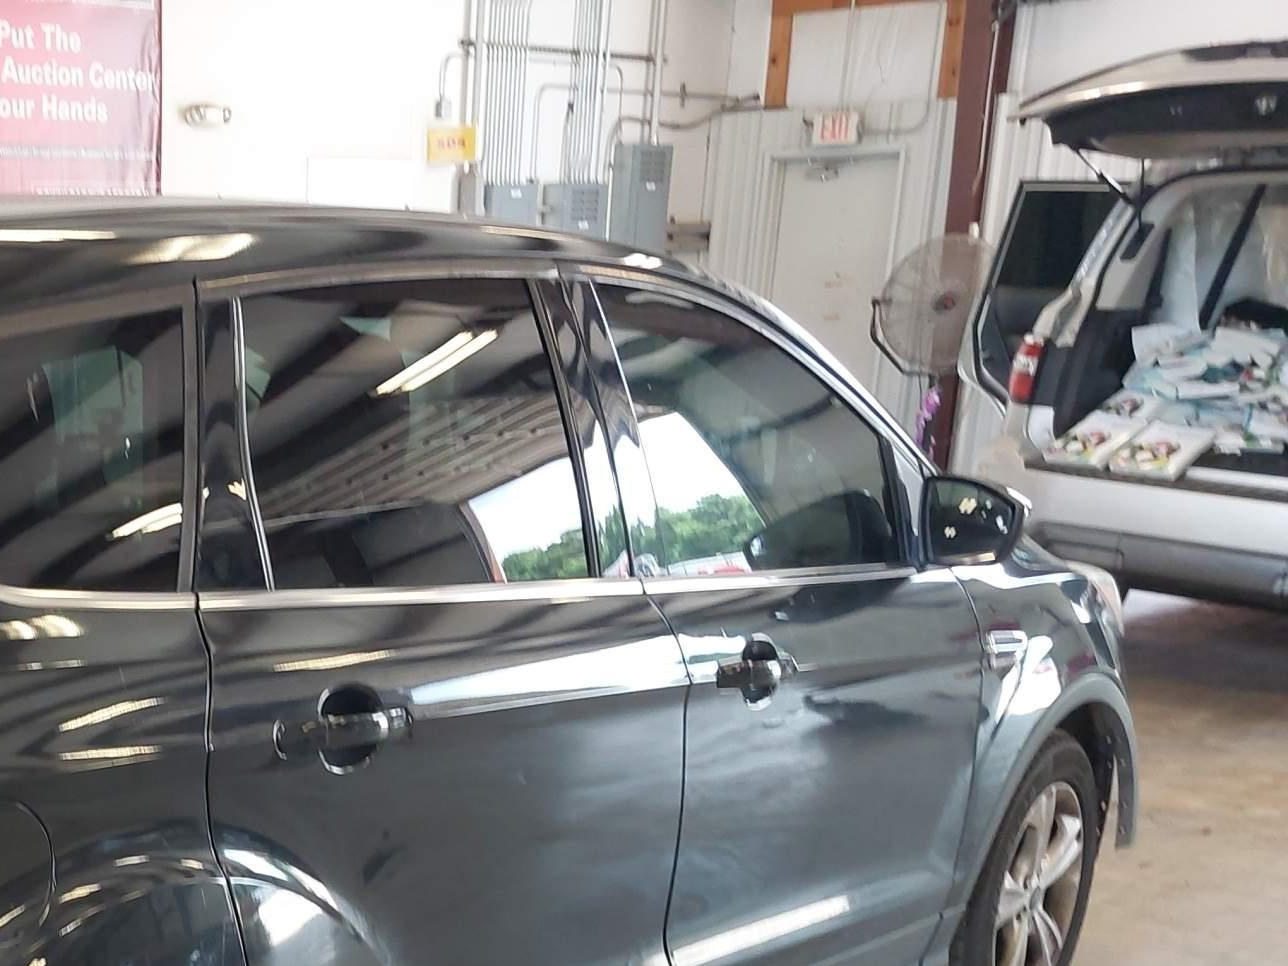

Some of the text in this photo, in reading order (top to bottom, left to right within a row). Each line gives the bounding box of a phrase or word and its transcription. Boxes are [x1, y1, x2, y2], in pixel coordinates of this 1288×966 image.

[40, 22, 82, 51] The
[1, 56, 84, 88] Auction
[40, 93, 109, 123] Hands
